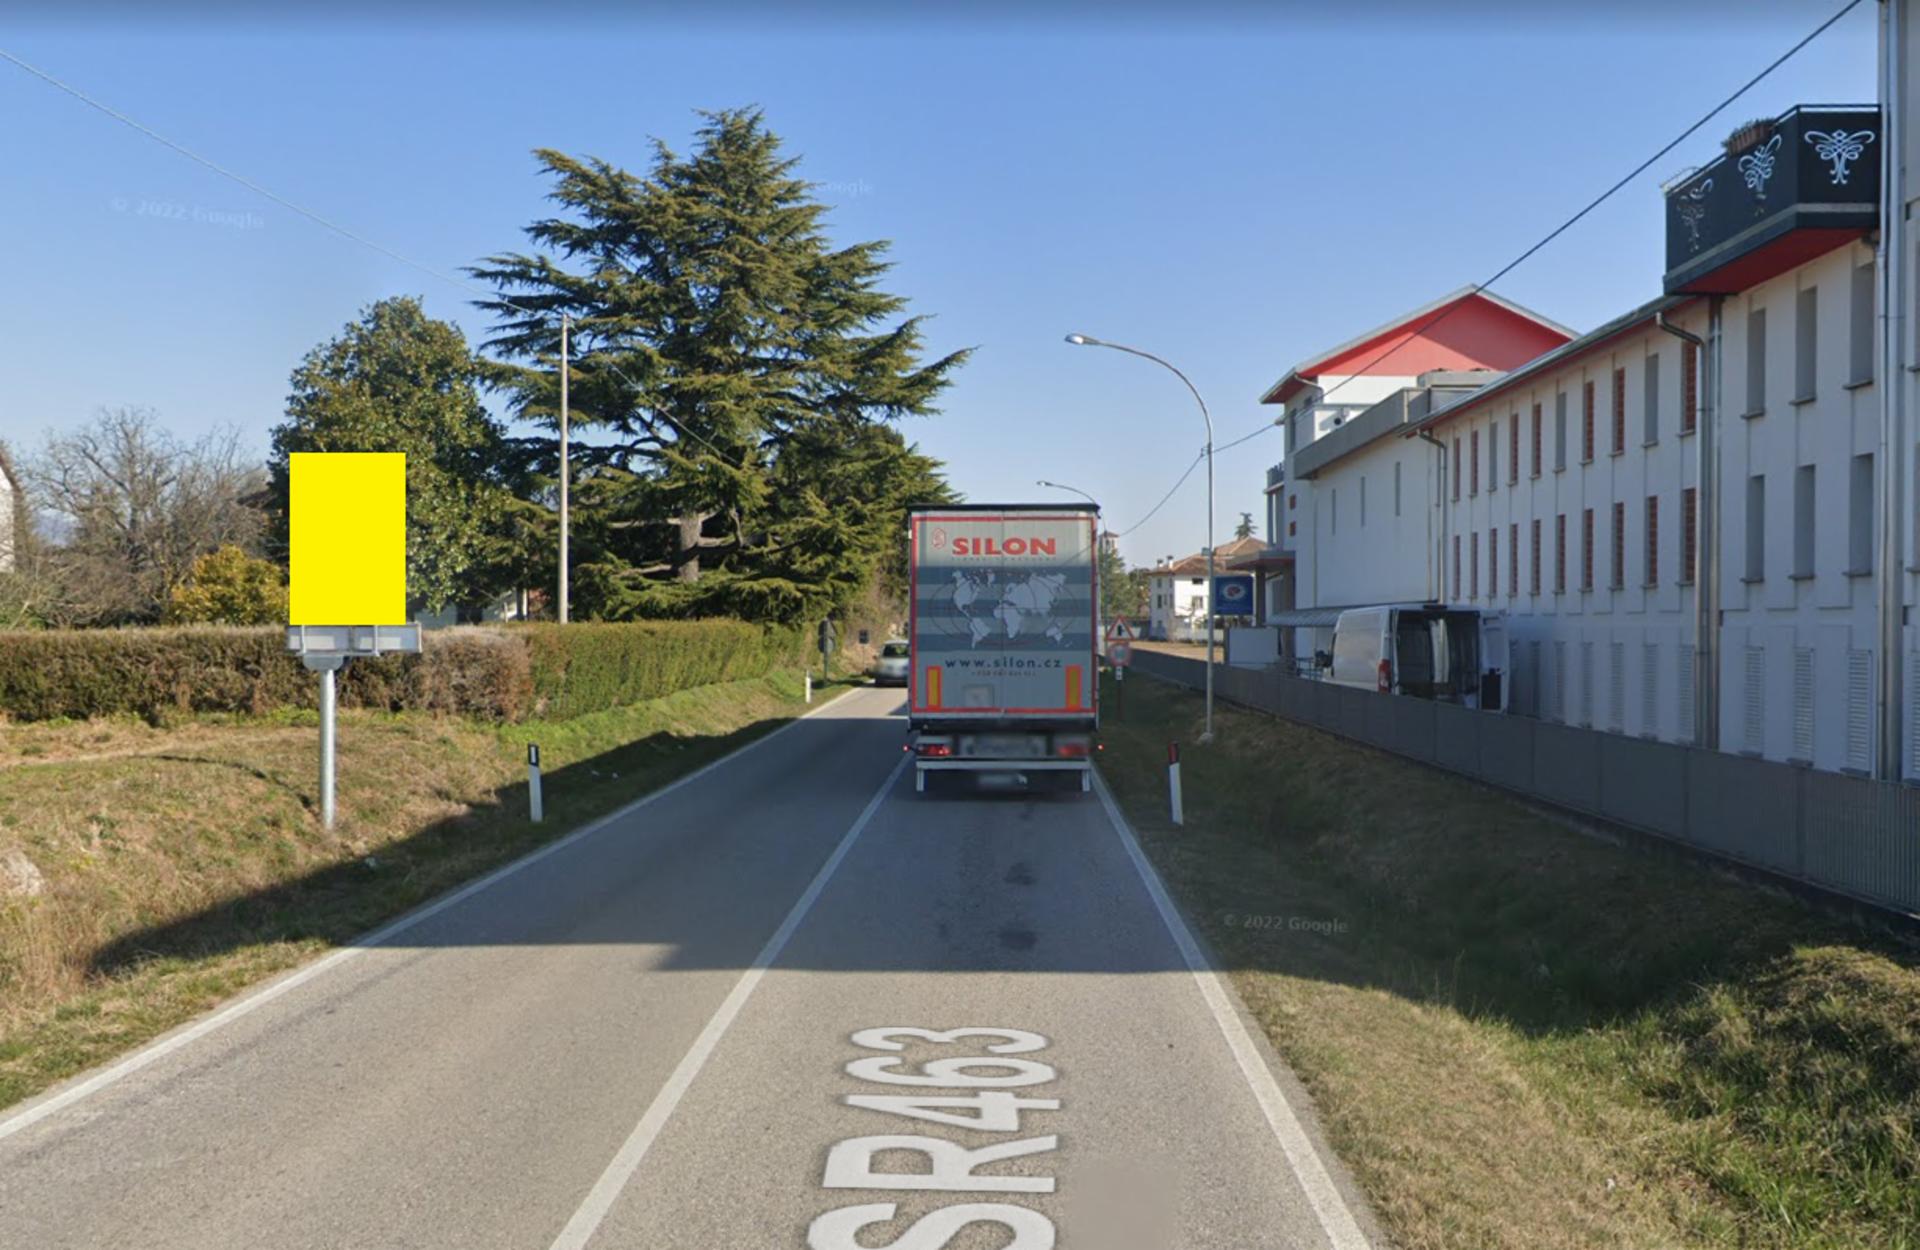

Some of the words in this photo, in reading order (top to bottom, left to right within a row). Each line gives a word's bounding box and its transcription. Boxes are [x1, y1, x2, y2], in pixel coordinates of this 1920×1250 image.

[952, 537, 1056, 555] SILON
[945, 656, 1062, 668] www.silon.cz
[807, 1027, 1060, 1250] SR463
